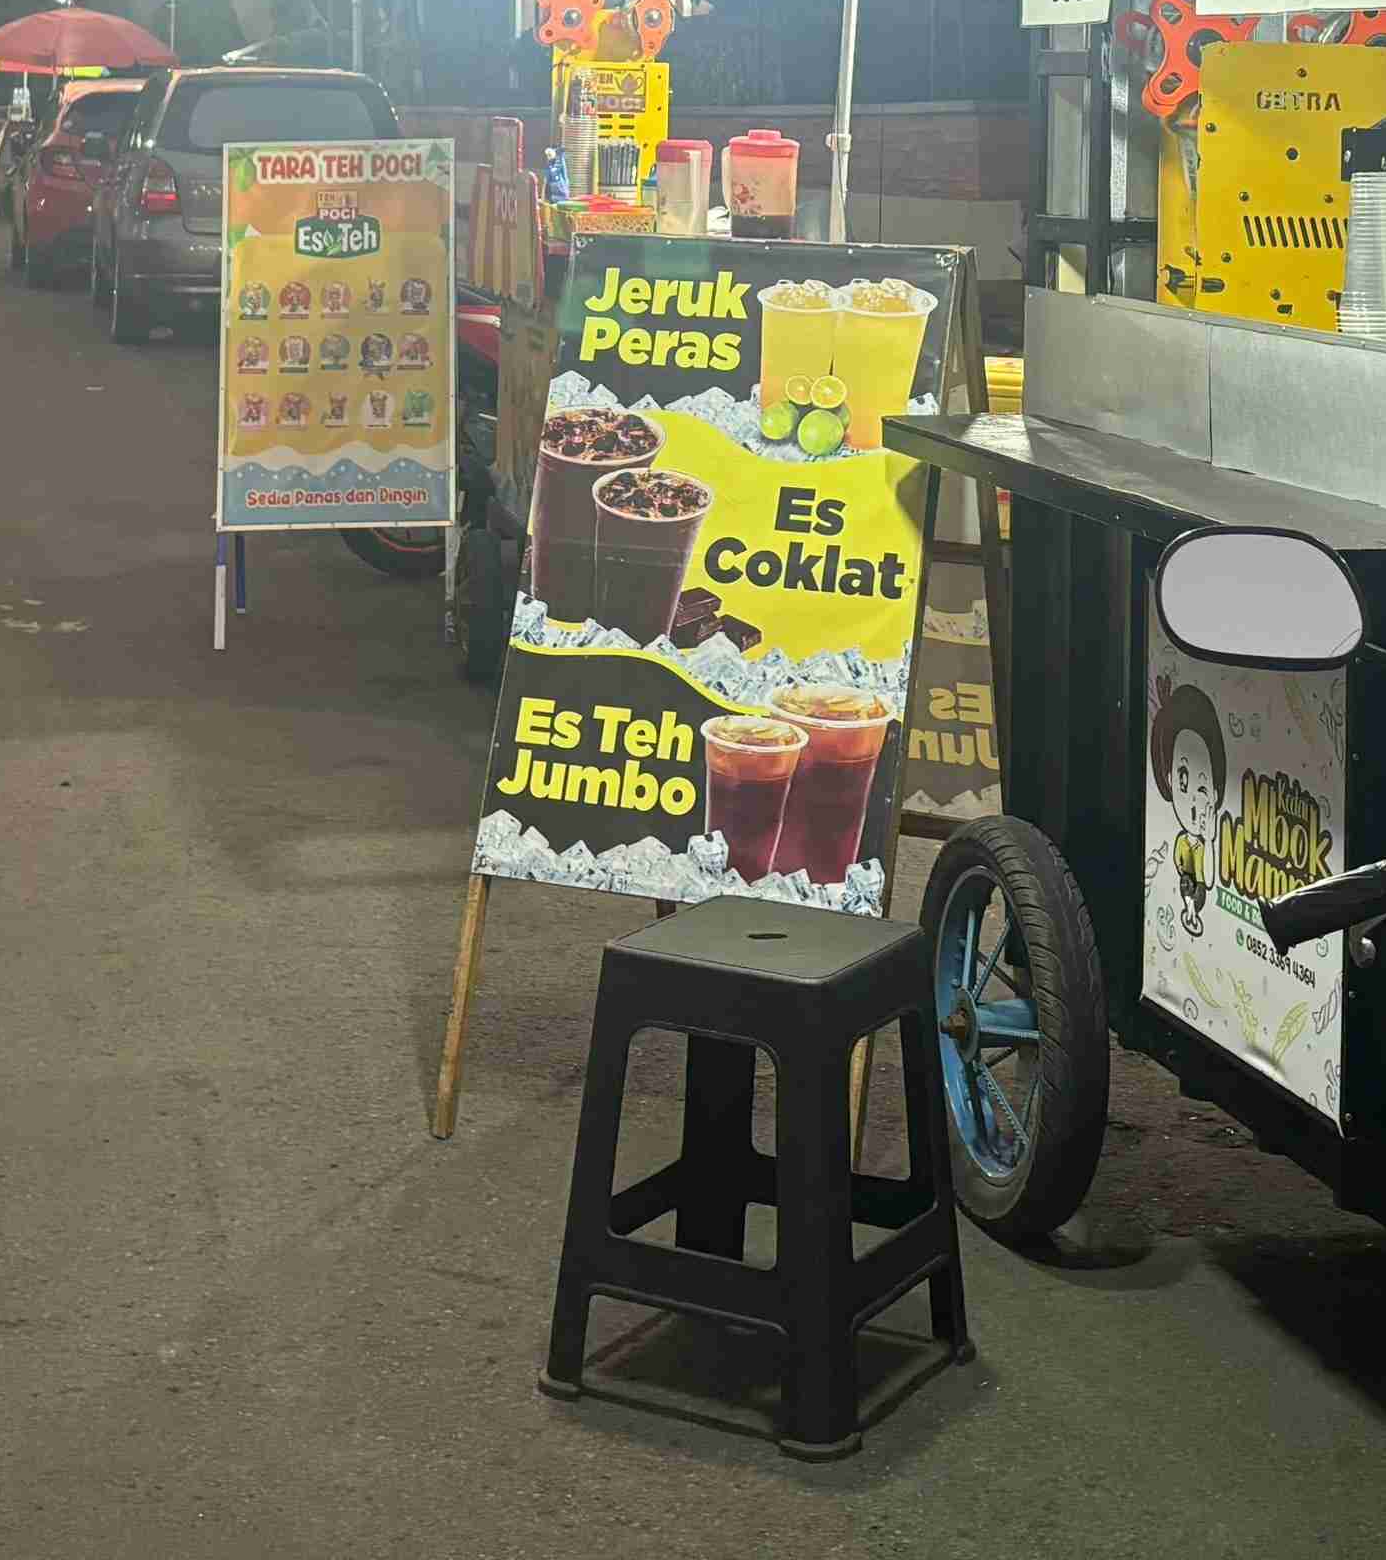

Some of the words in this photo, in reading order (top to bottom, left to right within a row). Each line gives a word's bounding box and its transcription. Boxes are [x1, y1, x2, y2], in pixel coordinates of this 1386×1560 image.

[1256, 90, 1341, 112] GETRA
[257, 155, 315, 180] TARA
[322, 154, 363, 178] TEH
[371, 152, 422, 178] POCI
[298, 226, 324, 252] Es
[338, 222, 378, 252] Teh
[319, 208, 356, 220] POCI
[584, 267, 752, 320] Jeruk
[579, 317, 741, 371] Peras
[247, 490, 291, 506] Sedia
[294, 491, 342, 505] Panas
[345, 490, 375, 504] dan
[379, 487, 428, 507] Dingin
[774, 487, 846, 536] Es
[704, 537, 905, 600] Coklat
[513, 697, 583, 748] Es
[592, 705, 694, 763] Teh
[497, 749, 696, 816] Jumbo
[1243, 775, 1333, 878] Mbok
[1221, 819, 1315, 903] Mam
[1246, 933, 1268, 961] 0852
